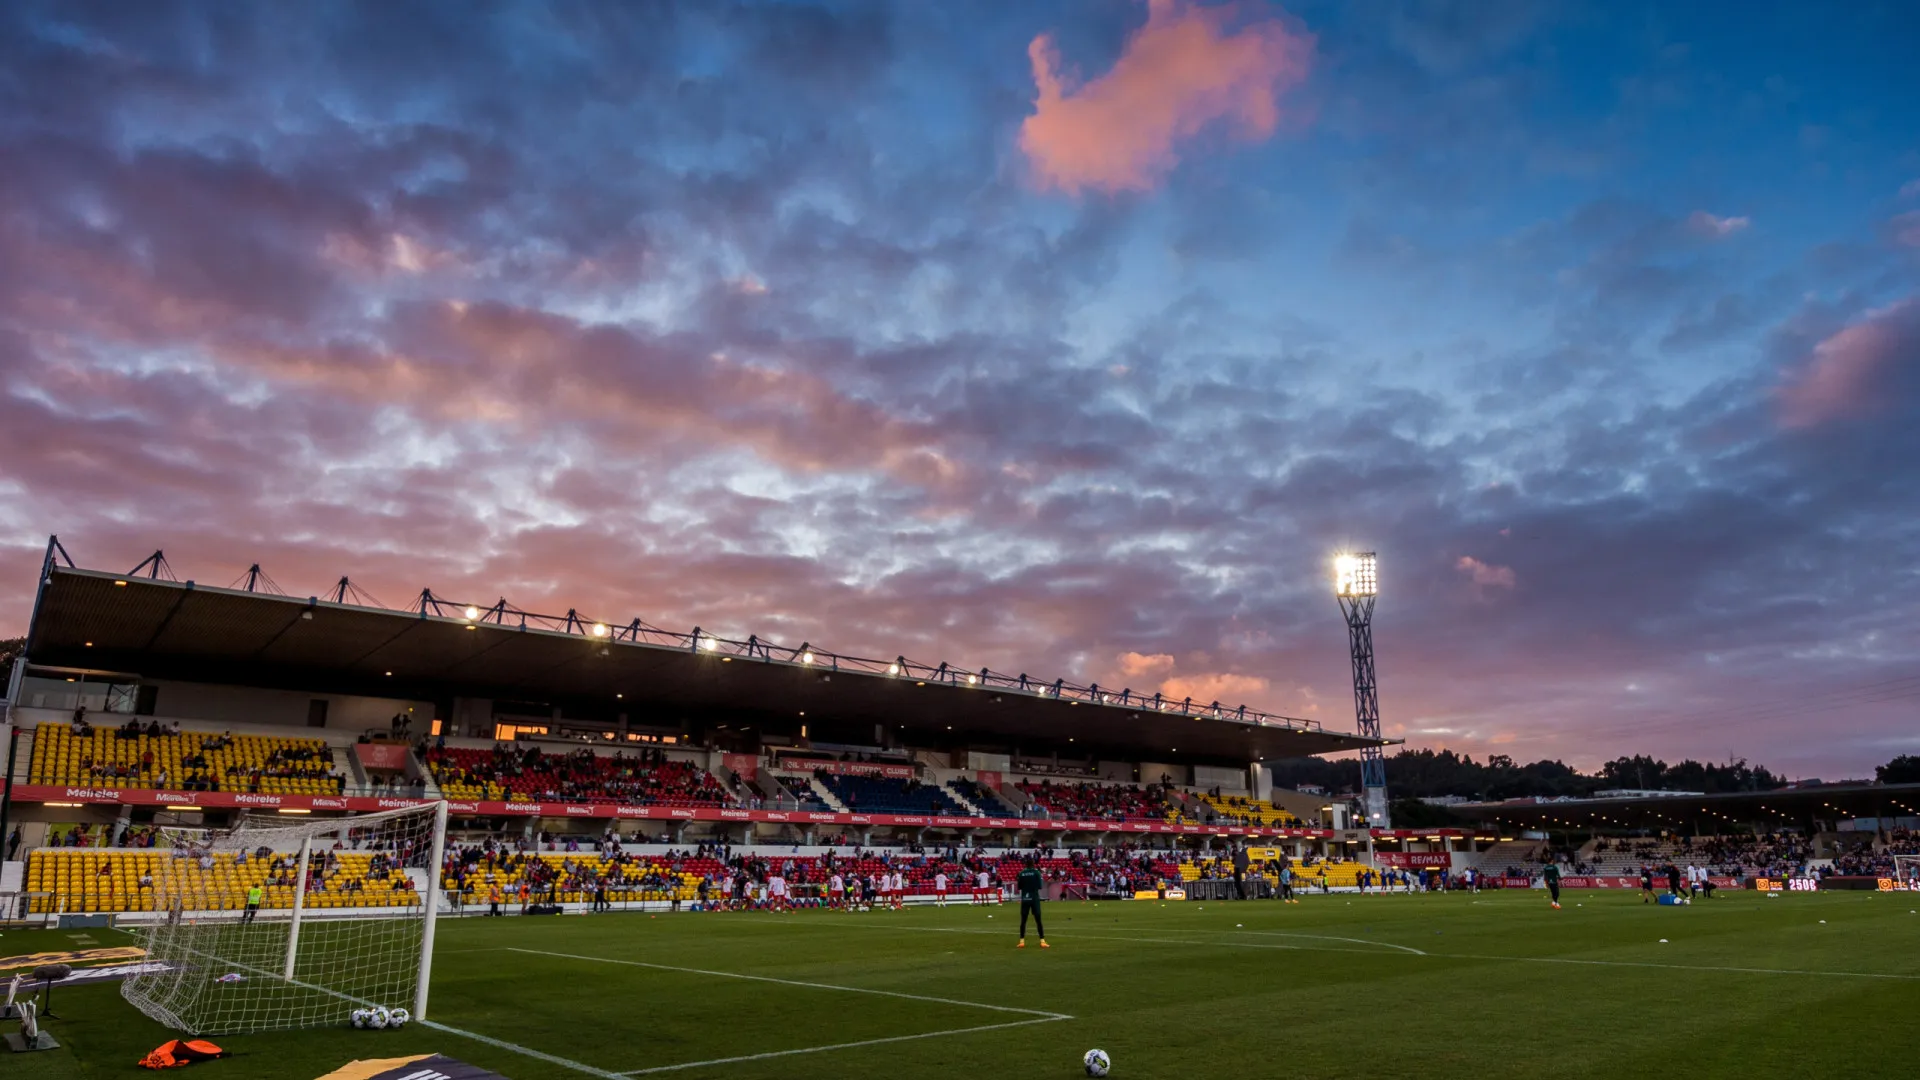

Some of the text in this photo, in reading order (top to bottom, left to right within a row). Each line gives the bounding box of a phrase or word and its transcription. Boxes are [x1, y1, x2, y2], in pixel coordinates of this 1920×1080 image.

[804, 762, 835, 771] VICENTE
[67, 789, 119, 799] Meireles
[235, 794, 281, 804] Meireles
[379, 799, 419, 808] Meireles
[506, 803, 541, 812] Meireles
[721, 810, 749, 818] Meireles
[1411, 855, 1446, 864] RE/MAX
[1789, 879, 1816, 890] 250€
